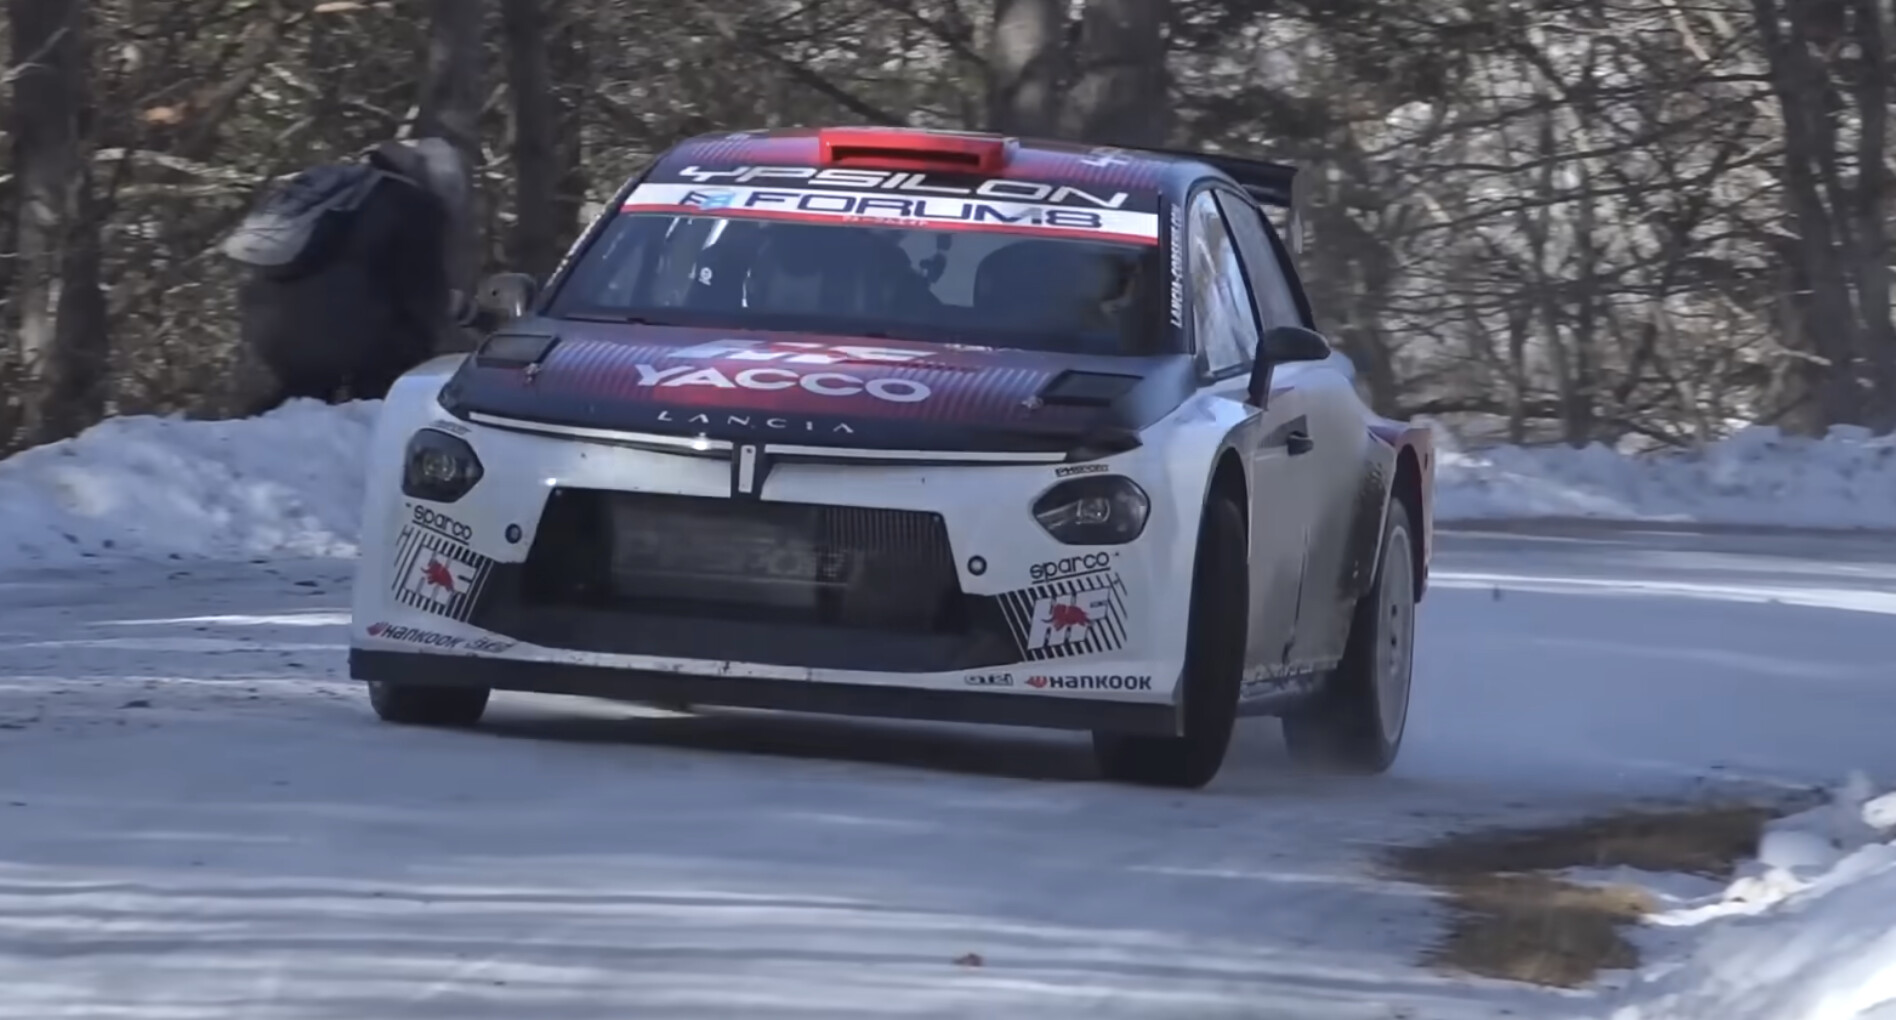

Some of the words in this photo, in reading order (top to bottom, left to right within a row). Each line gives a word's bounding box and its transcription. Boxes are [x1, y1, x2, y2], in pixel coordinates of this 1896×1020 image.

[679, 166, 1129, 209] YPSILON
[744, 191, 1103, 229] FORUM8
[635, 364, 932, 402] YACCO
[657, 410, 855, 433] LANCIA
[413, 504, 473, 541] sparco
[1029, 551, 1110, 583] sparco
